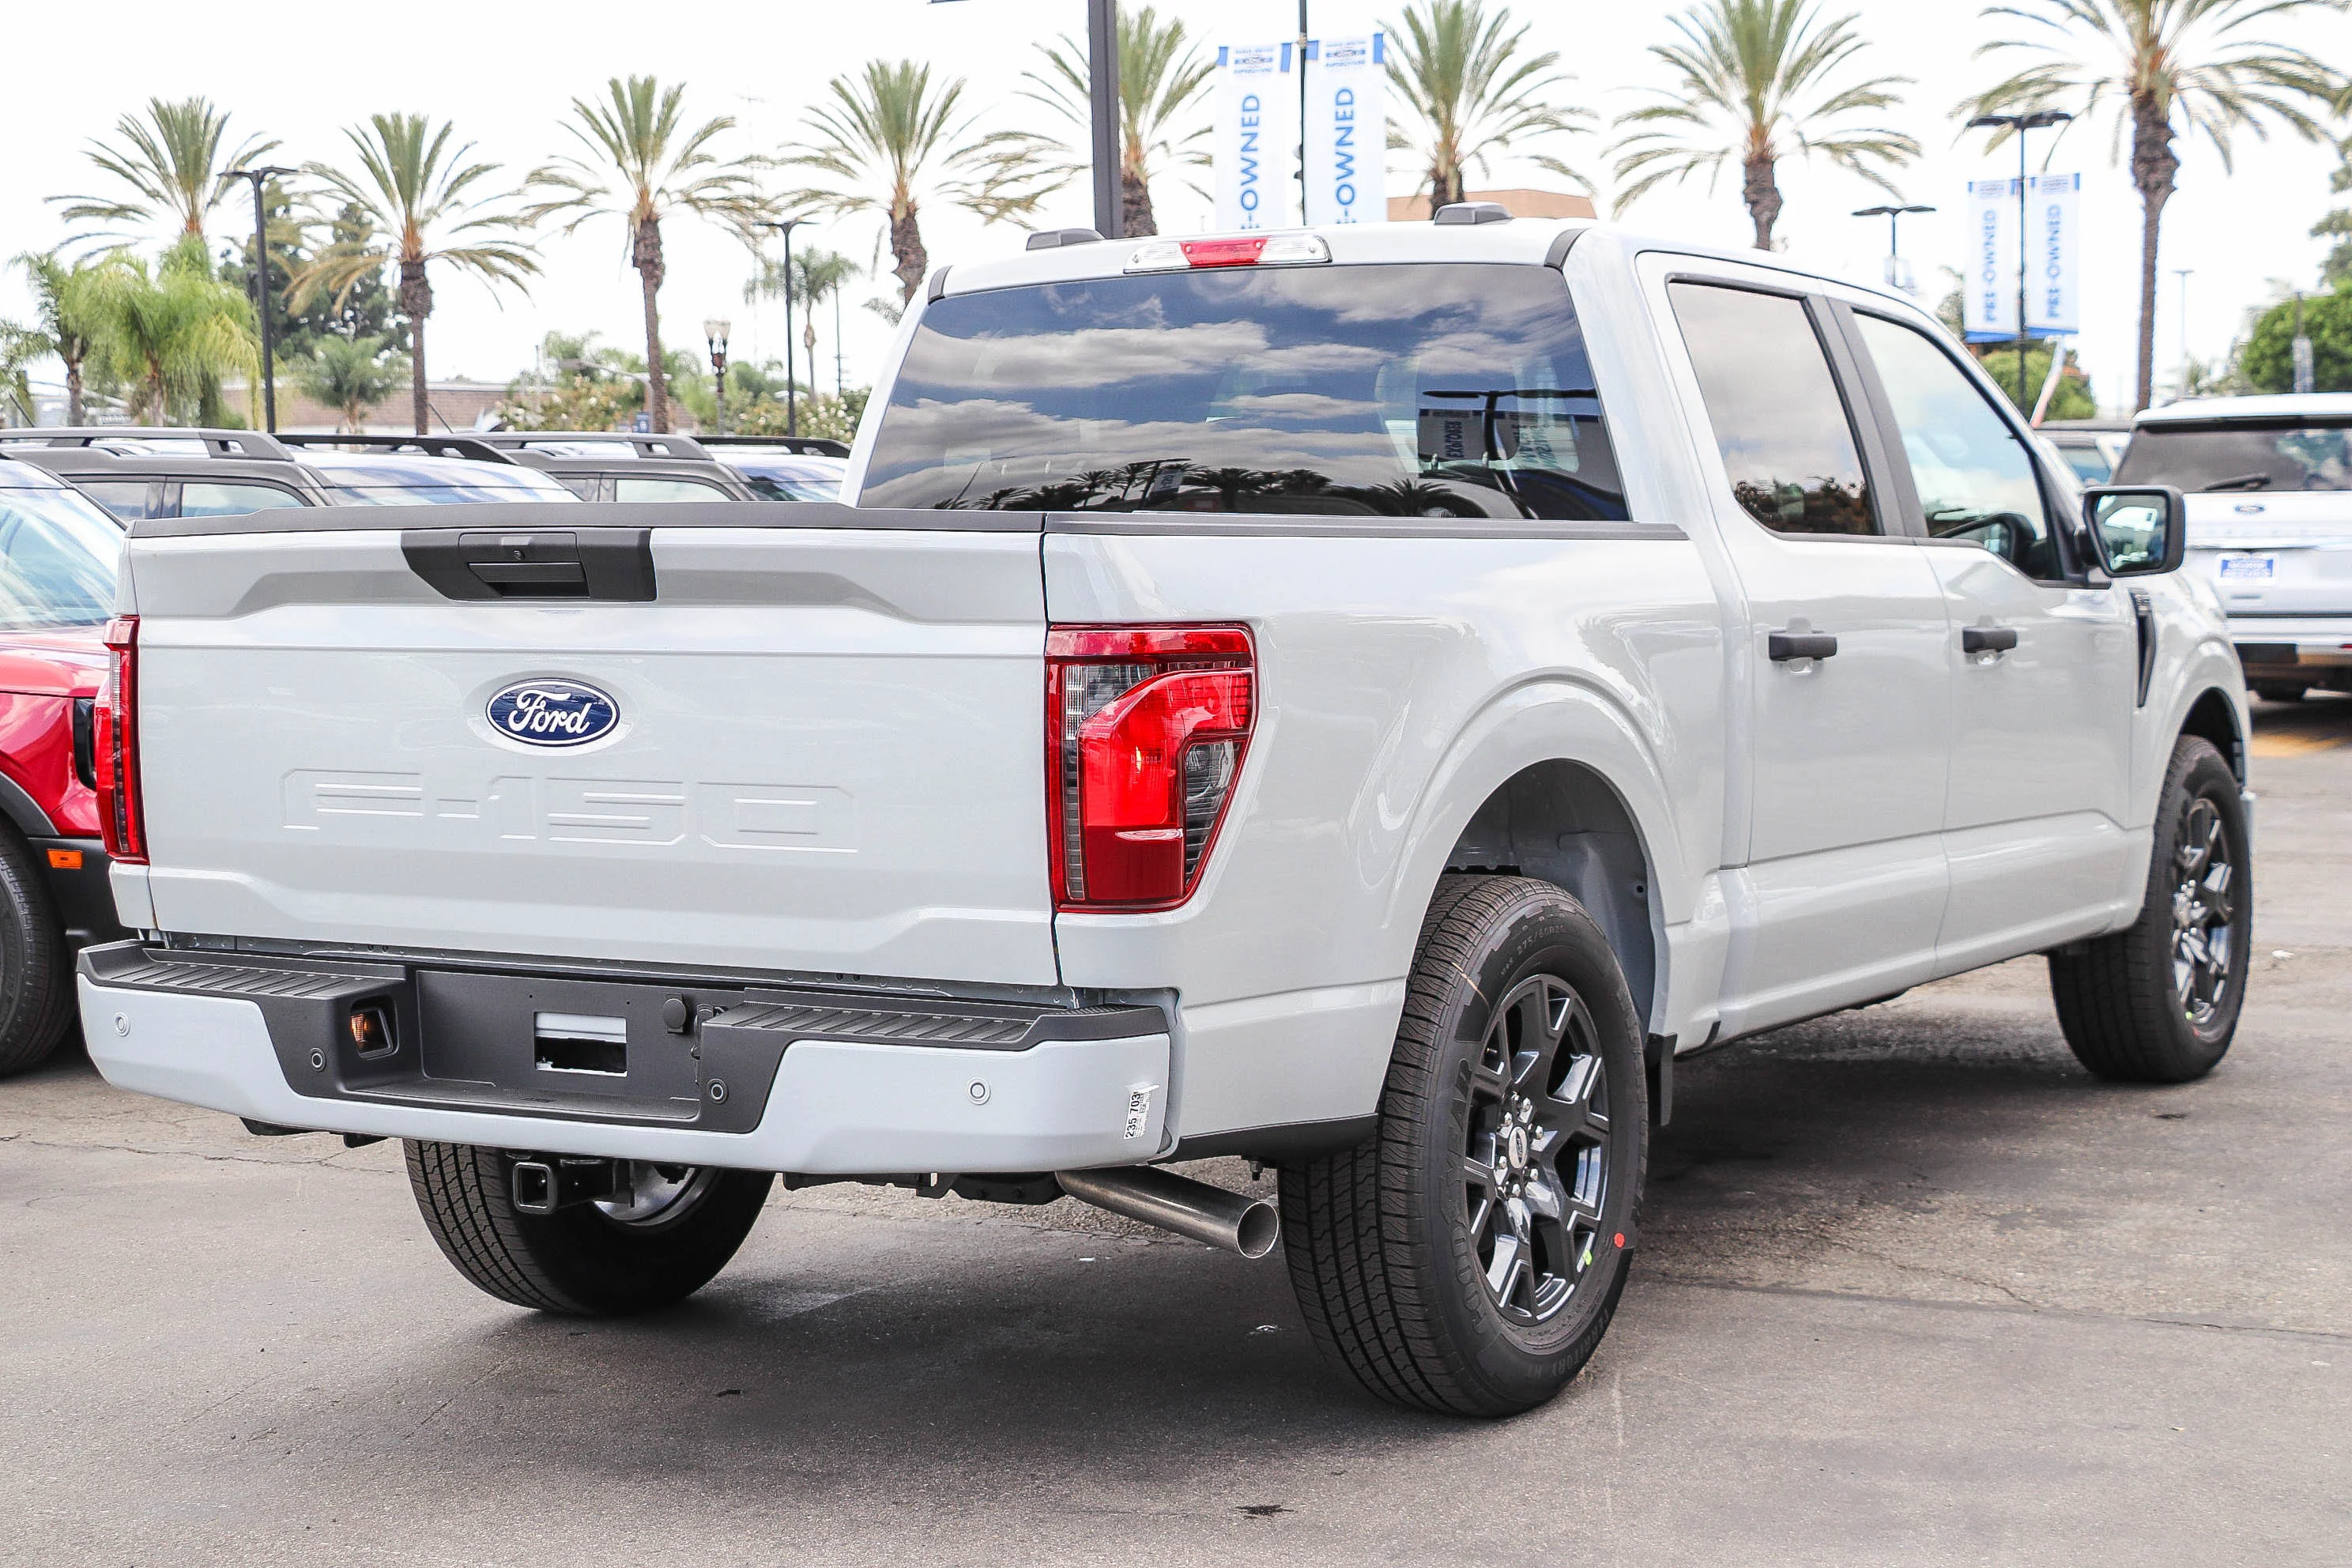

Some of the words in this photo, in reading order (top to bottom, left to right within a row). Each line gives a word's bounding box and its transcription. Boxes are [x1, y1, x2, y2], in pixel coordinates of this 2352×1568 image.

[508, 689, 592, 734] Ford
[281, 767, 859, 854] F-150
[1125, 1118, 1136, 1138] 235
